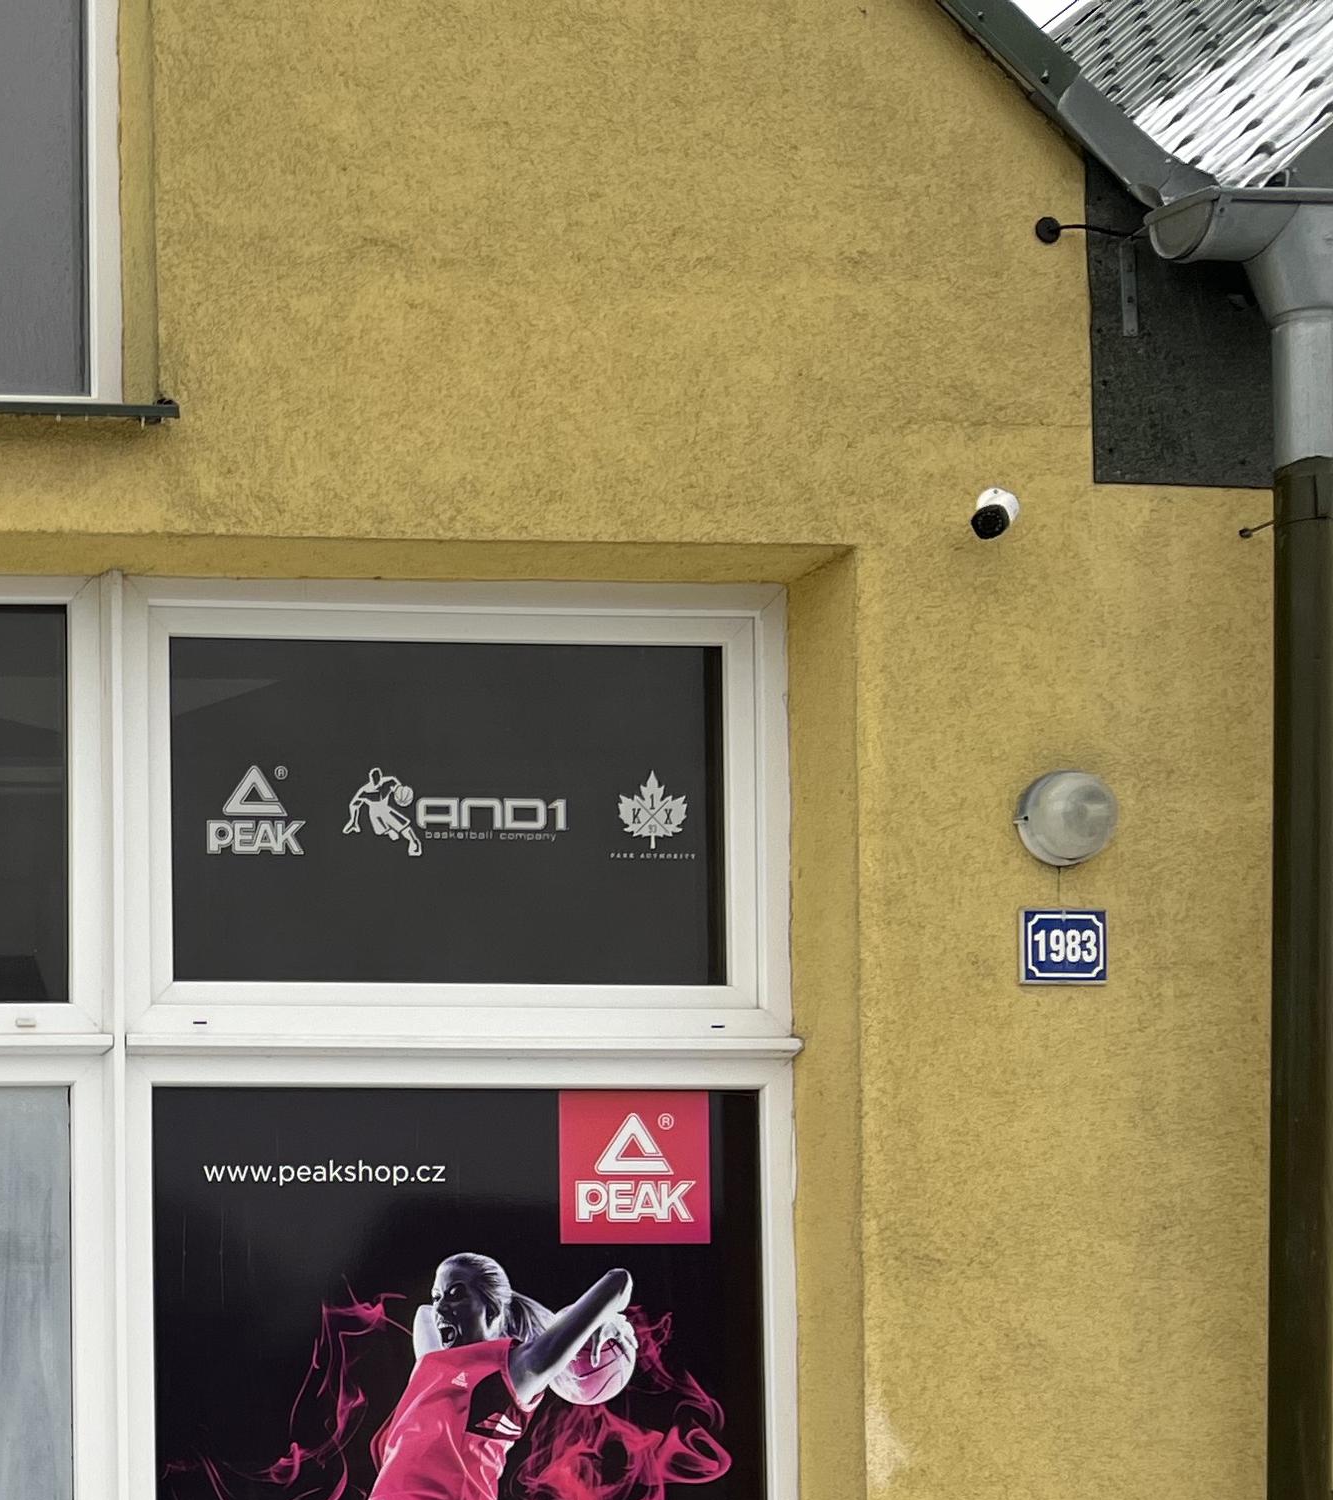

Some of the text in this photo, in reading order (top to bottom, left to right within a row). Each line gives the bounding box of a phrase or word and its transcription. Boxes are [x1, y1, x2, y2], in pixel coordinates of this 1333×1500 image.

[415, 796, 568, 831] AND1
[206, 819, 306, 855] PEAK
[424, 830, 557, 842] basketball company
[1033, 928, 1098, 963] 1983
[203, 1159, 447, 1186] www.peakshop.cz
[574, 1180, 697, 1223] PEAK
